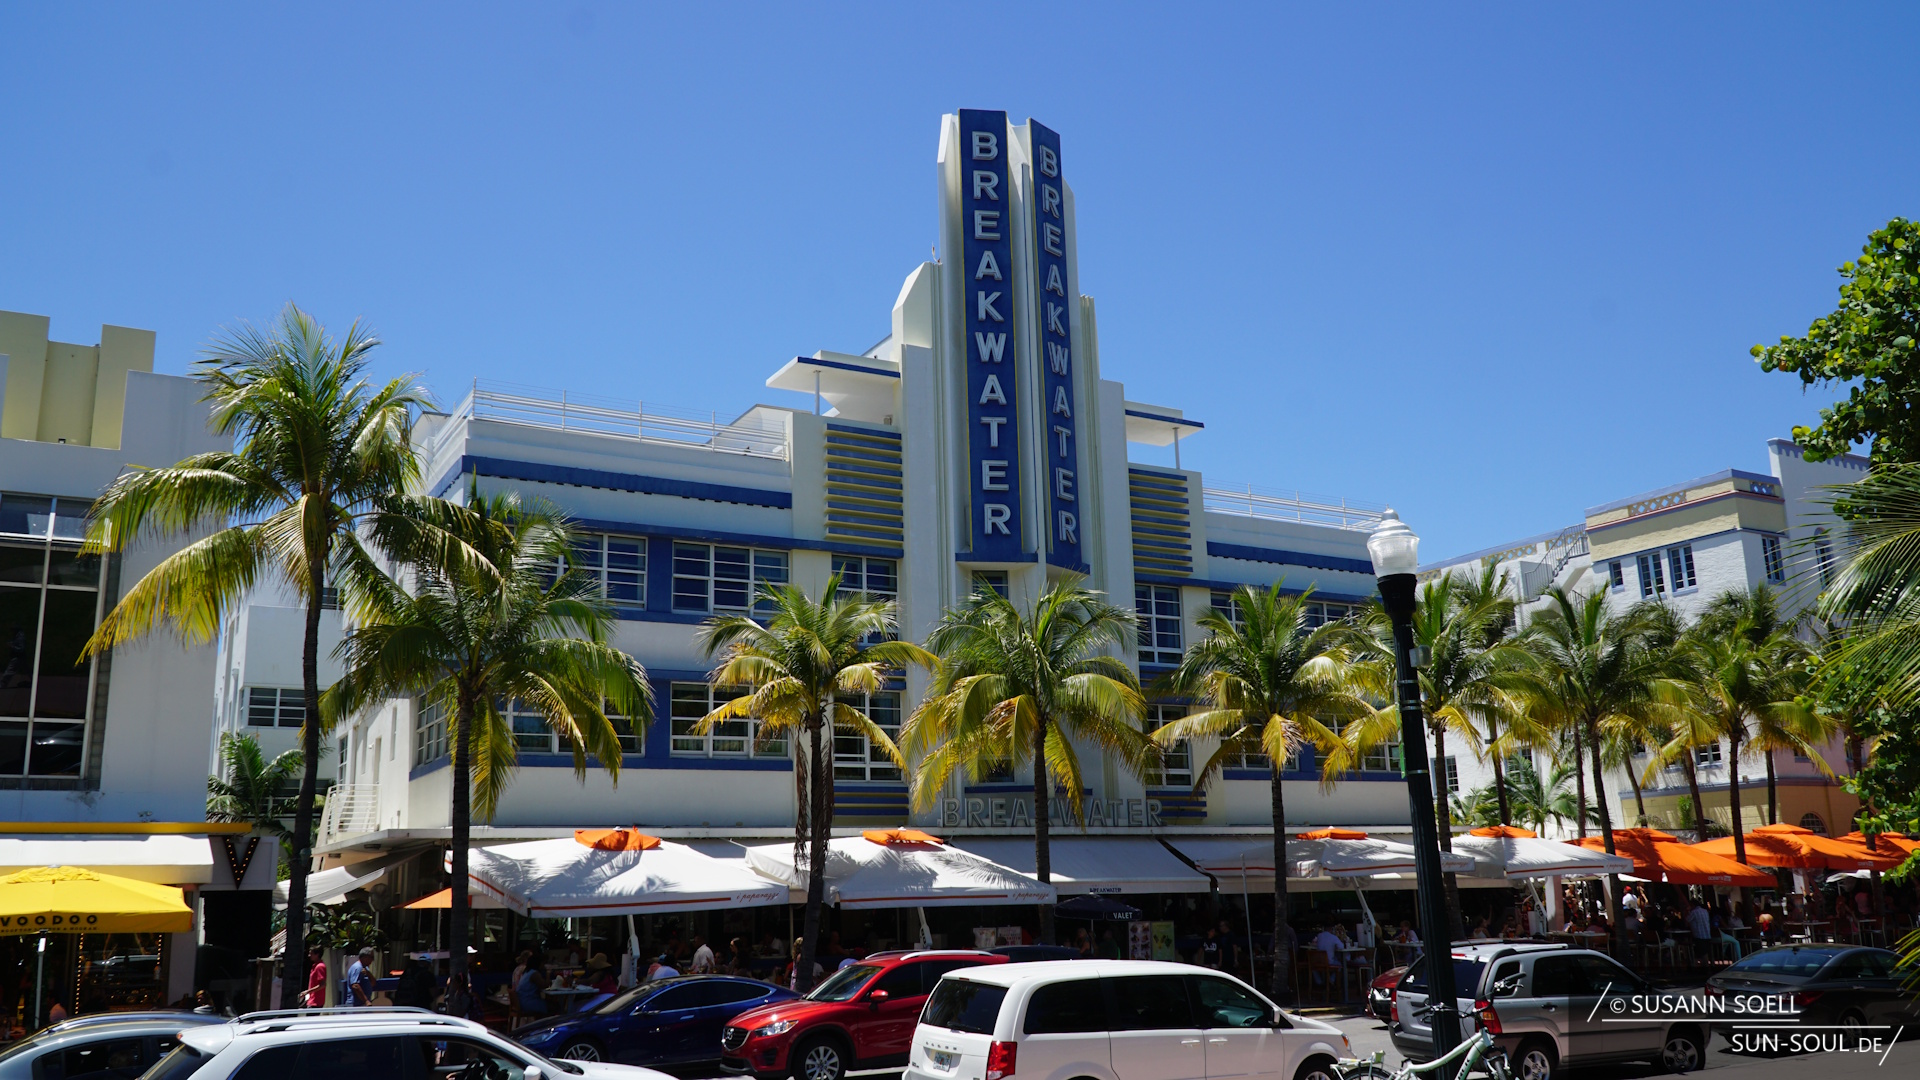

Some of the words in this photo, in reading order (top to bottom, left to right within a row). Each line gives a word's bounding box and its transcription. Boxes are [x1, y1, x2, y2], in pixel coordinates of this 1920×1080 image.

[972, 131, 1011, 536] BREAKWATER
[1039, 145, 1077, 545] BREAKWATER
[942, 797, 1164, 828] BREAWATER
[222, 836, 261, 890] V
[0, 915, 97, 926] VOODOO
